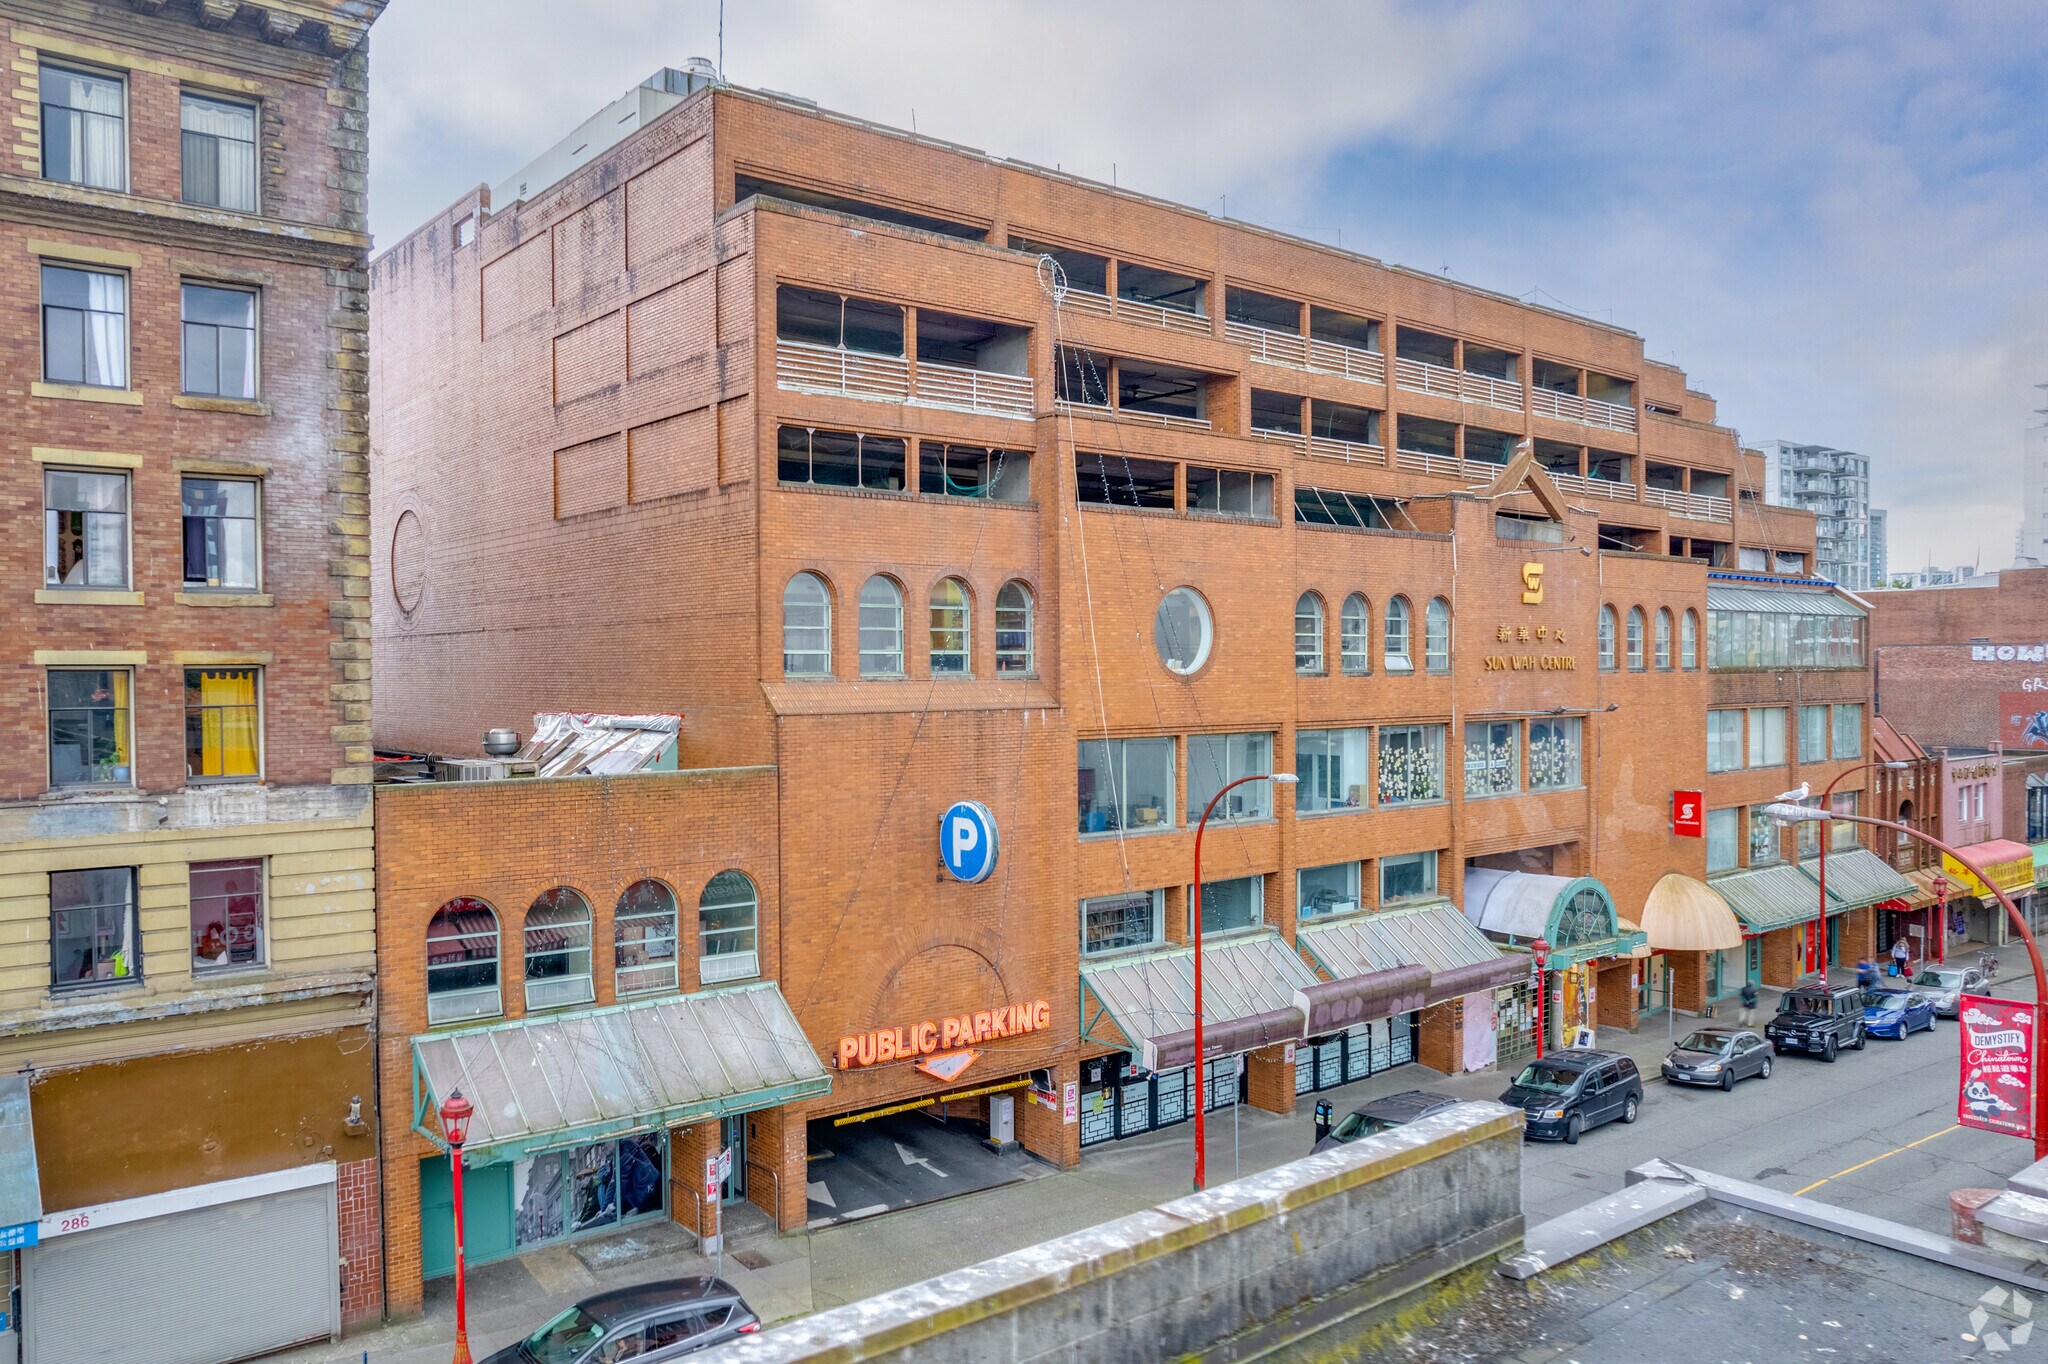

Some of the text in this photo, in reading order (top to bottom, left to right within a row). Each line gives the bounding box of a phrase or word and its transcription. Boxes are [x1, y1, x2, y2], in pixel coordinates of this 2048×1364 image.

[1484, 655, 1577, 670] SUN WAH CENTRE
[953, 816, 978, 867] P
[840, 1000, 1050, 1068] PUBLIC PARKING
[1974, 1032, 2021, 1046] DEMYSTIFY
[1968, 1049, 2029, 1064] Chinatown
[61, 1216, 90, 1232] 286
